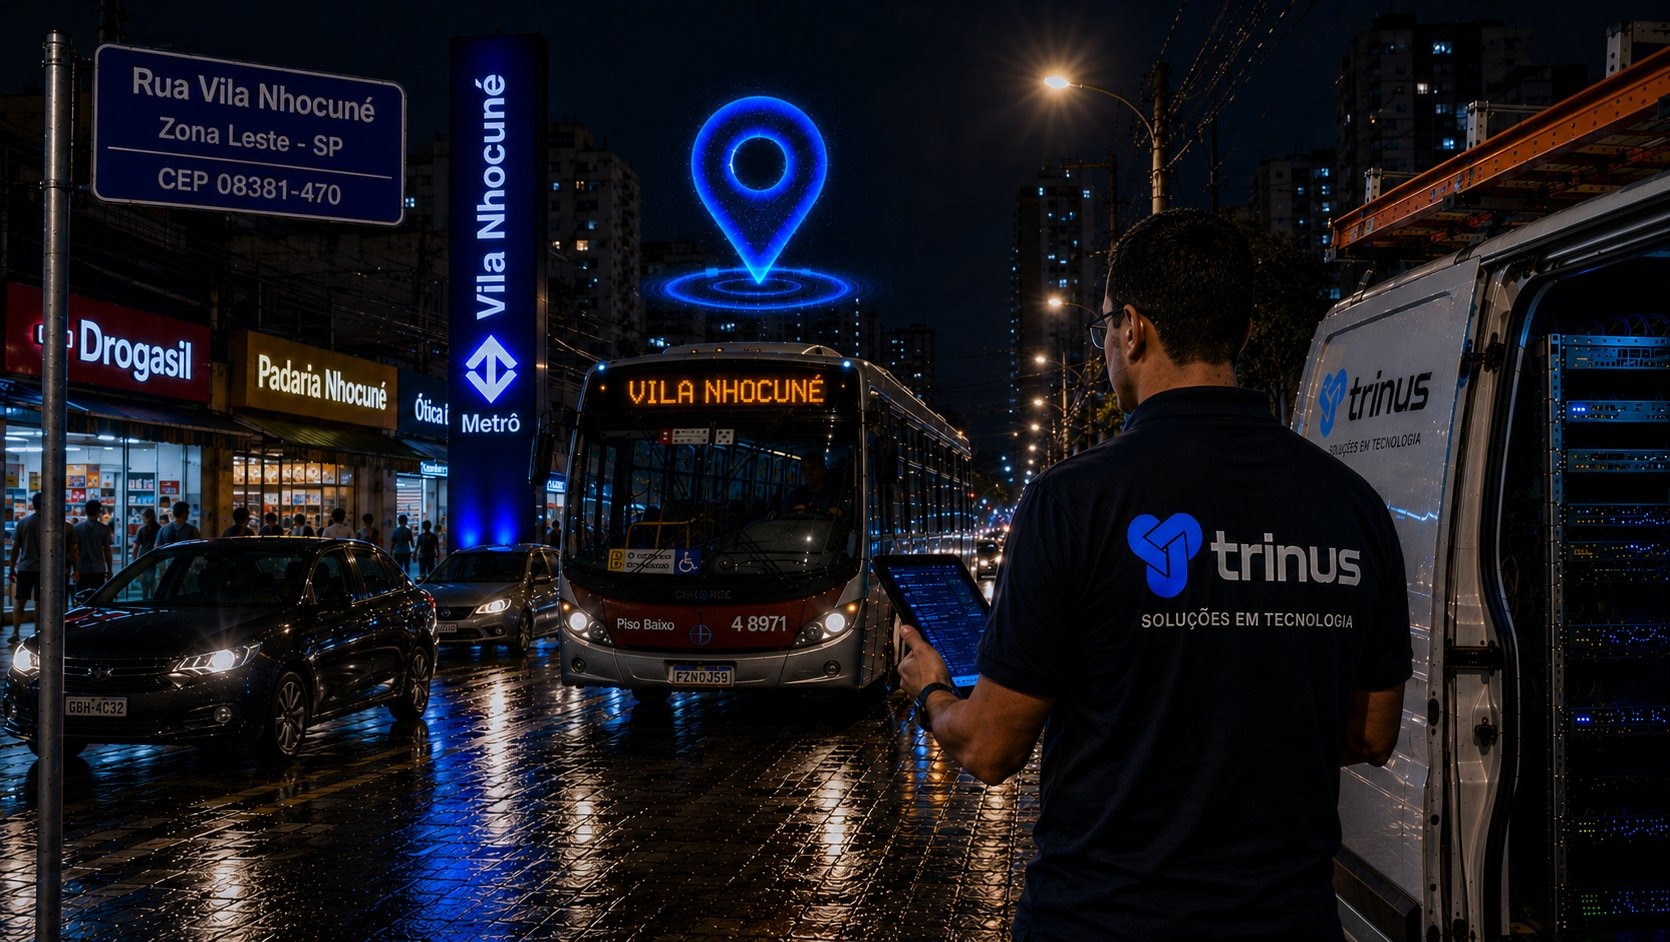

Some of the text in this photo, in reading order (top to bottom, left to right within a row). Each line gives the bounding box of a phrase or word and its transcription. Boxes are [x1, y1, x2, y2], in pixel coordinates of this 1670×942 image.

[132, 66, 376, 123] Rua Vila Nhocuné
[158, 116, 220, 145] Zona
[228, 123, 290, 153] Leste
[313, 134, 344, 158] SP
[158, 167, 342, 206] CEP 08381-470
[474, 73, 506, 321] Vila Nhocuné
[79, 318, 193, 382] Drogasil
[258, 353, 387, 411] Padaria Nhocuné
[628, 374, 824, 404] VILA NHOCUNÉ
[1348, 370, 1432, 421] trinus
[414, 392, 443, 424] Ótica
[462, 413, 521, 433] Metrô
[1372, 433, 1421, 451] TECNOLOGIA
[1210, 530, 1361, 587] trinus
[616, 617, 675, 631] Piso Baixo
[731, 615, 787, 632] 4 8971
[1141, 607, 1353, 630] SOLUÇÕES EM TECNOLOGIA
